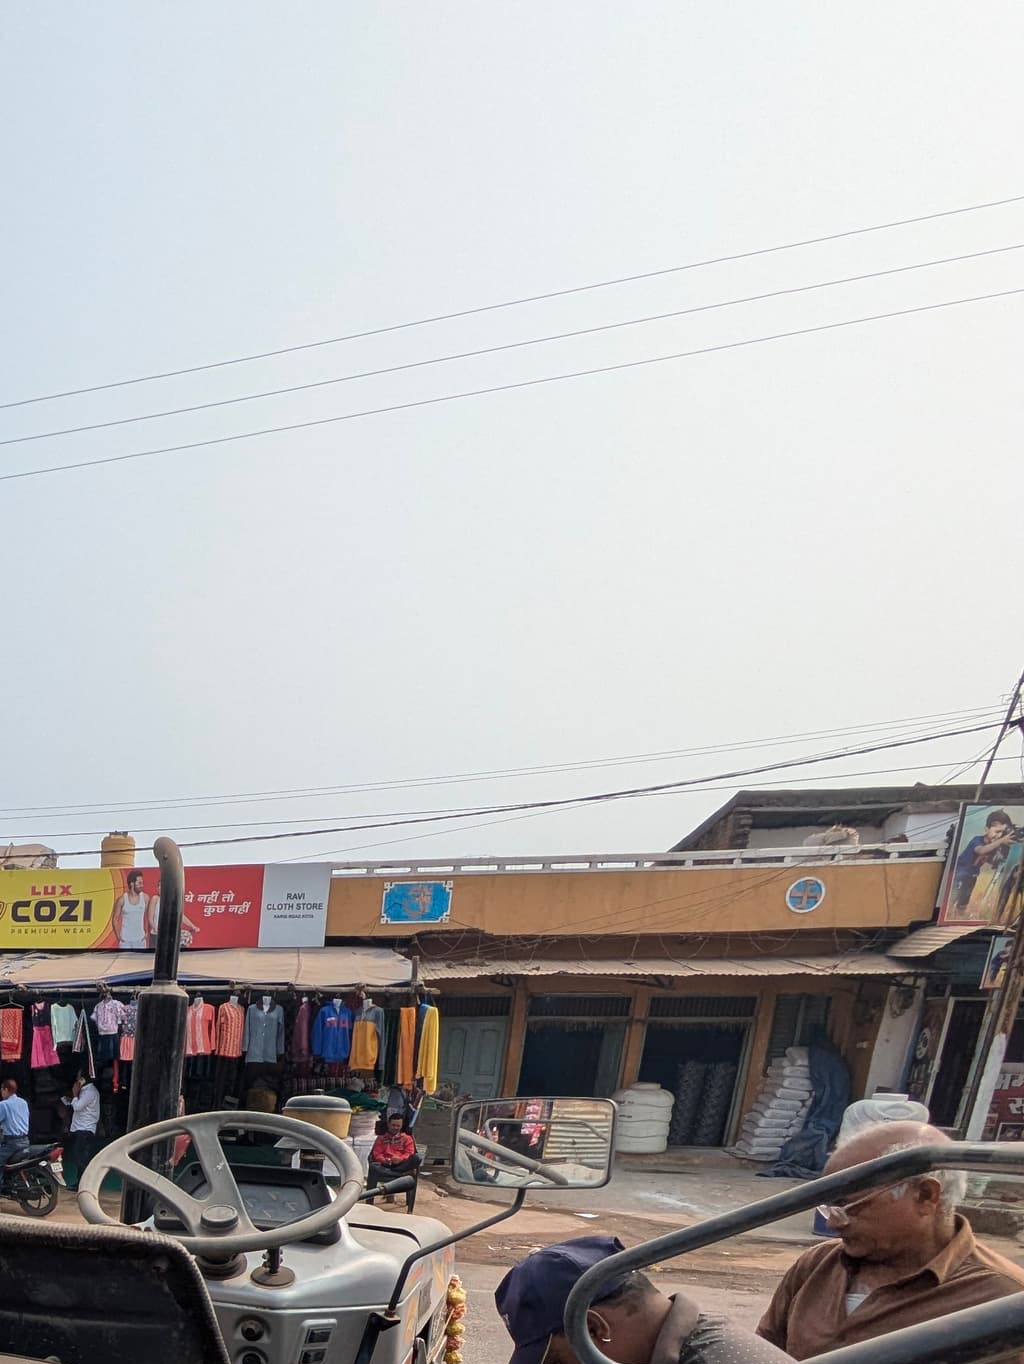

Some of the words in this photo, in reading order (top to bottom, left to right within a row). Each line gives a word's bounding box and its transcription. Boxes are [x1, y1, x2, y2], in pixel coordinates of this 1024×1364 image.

[30, 885, 72, 896] LUX
[286, 892, 305, 900] RAVI
[184, 890, 194, 903] ये
[197, 890, 220, 904] नहीं
[221, 890, 235, 903] तो
[11, 900, 93, 922] COZI
[204, 905, 226, 917] कुछ
[228, 901, 251, 915] नहीं
[266, 903, 294, 911] CLOTH
